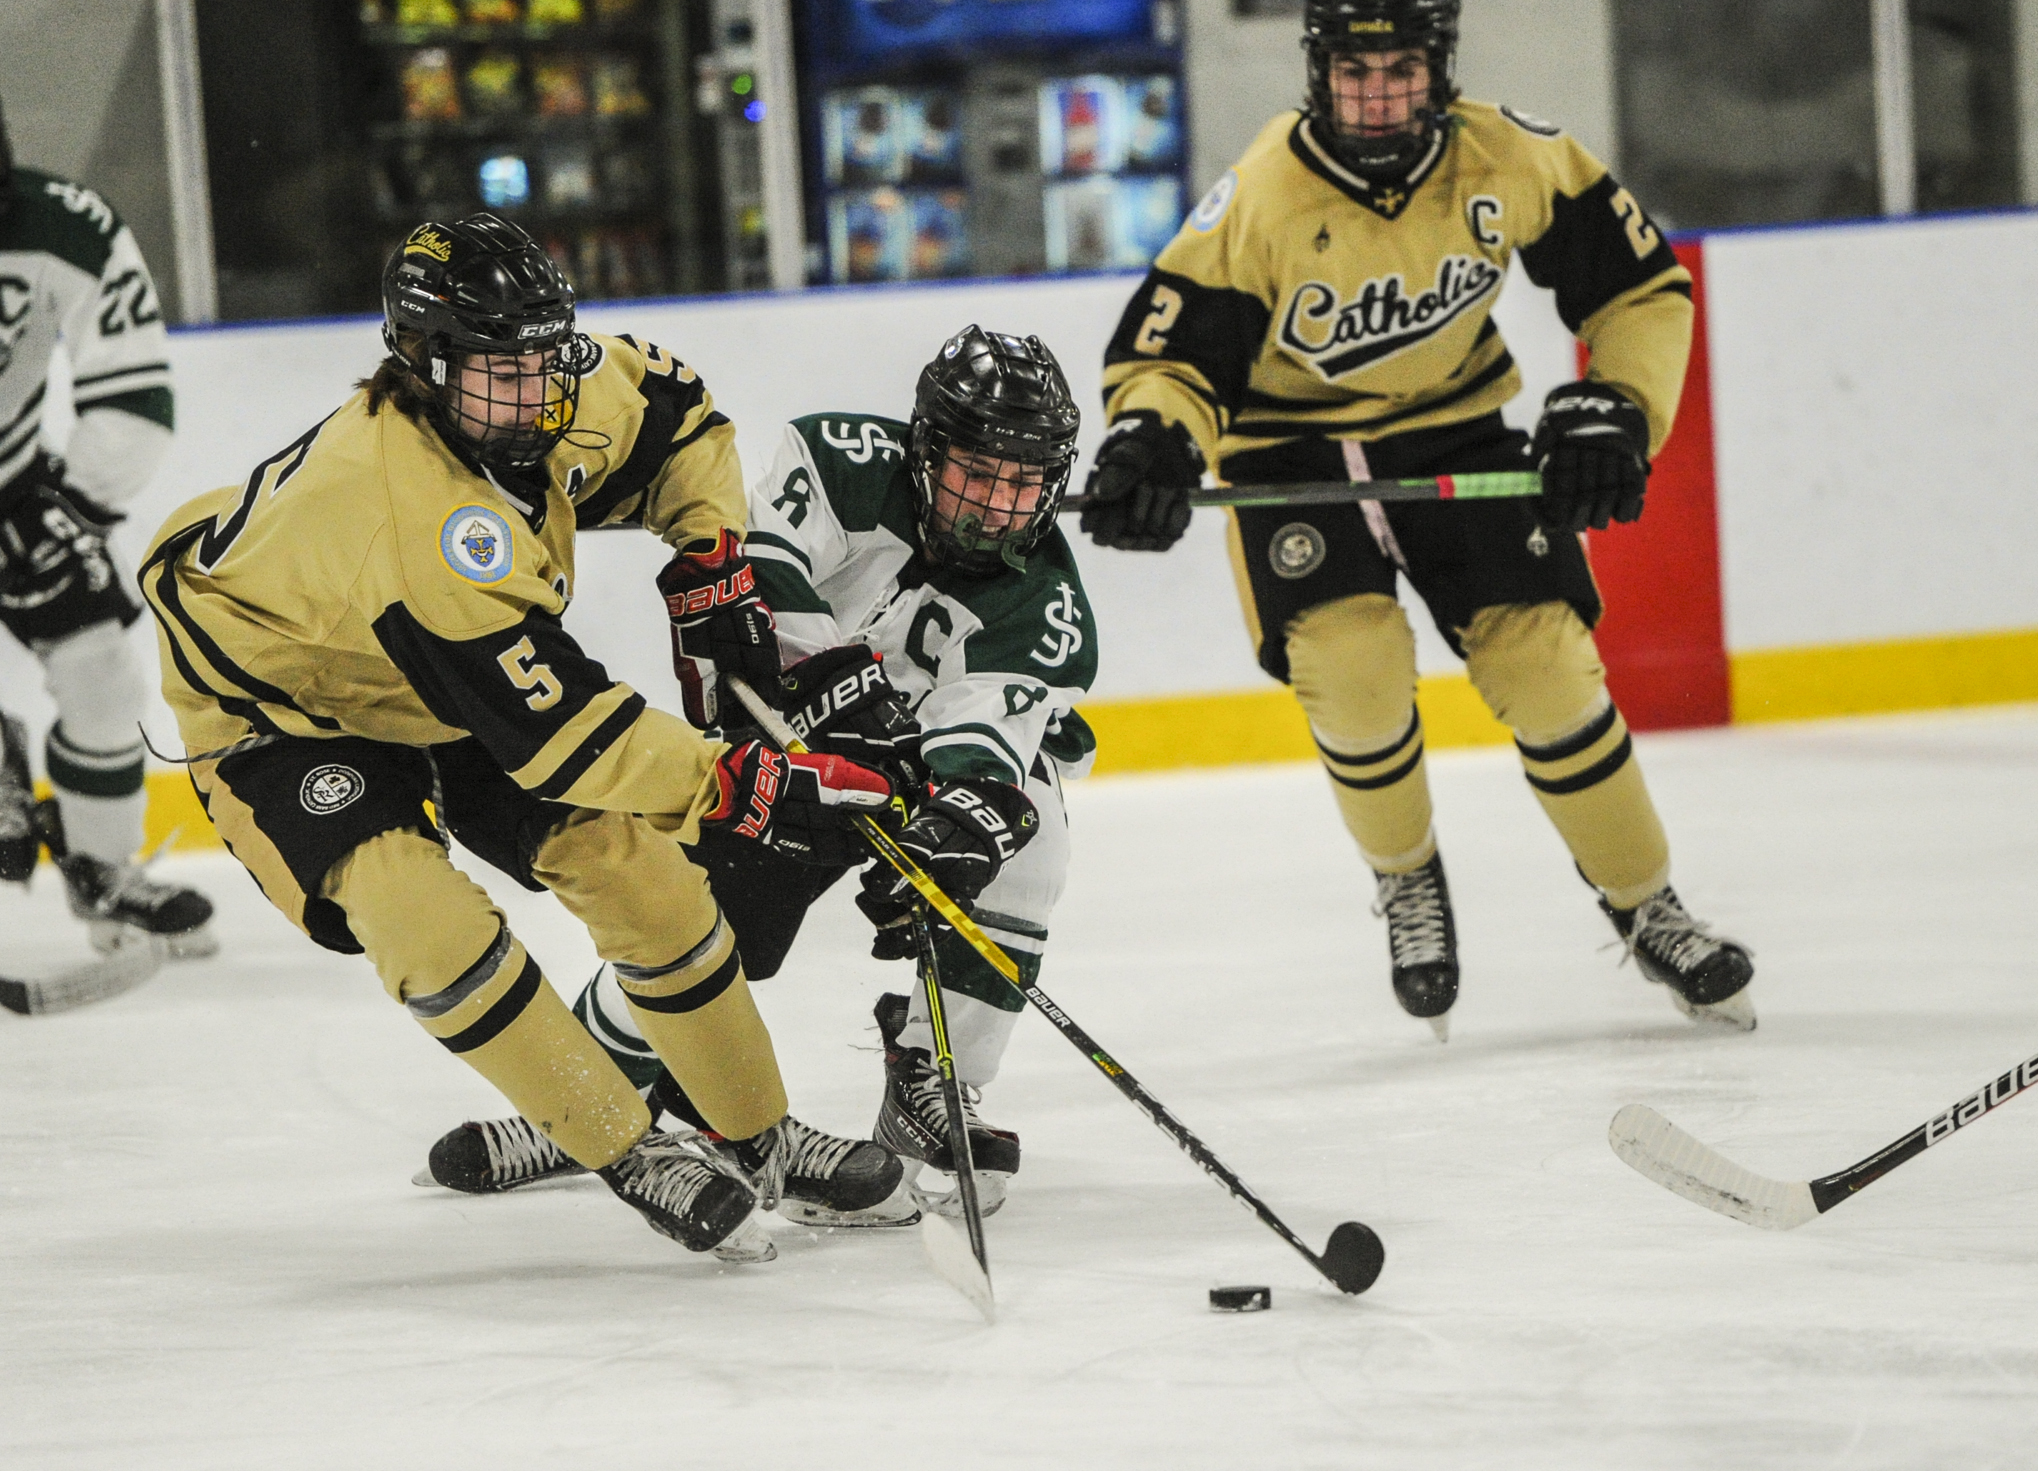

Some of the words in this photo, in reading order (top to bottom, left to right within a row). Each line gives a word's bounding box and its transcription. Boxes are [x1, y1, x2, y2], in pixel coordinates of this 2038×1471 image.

[405, 225, 453, 261] Catholic
[1467, 195, 1502, 245] C
[1609, 186, 1660, 261] 2
[100, 269, 158, 337] 22
[401, 299, 426, 314] CCM
[521, 319, 567, 338] CCM
[1134, 284, 1183, 356] 2
[1277, 256, 1501, 362] Catholic
[665, 562, 756, 617] BAUE
[496, 634, 564, 713] 5
[905, 599, 954, 679] C
[788, 662, 887, 740] AUER
[732, 746, 783, 839] AUER
[940, 787, 1016, 863] BAU
[1025, 986, 1072, 1029] BAUER
[896, 1115, 927, 1149] CCM
[1926, 1053, 2038, 1148] BAUE
